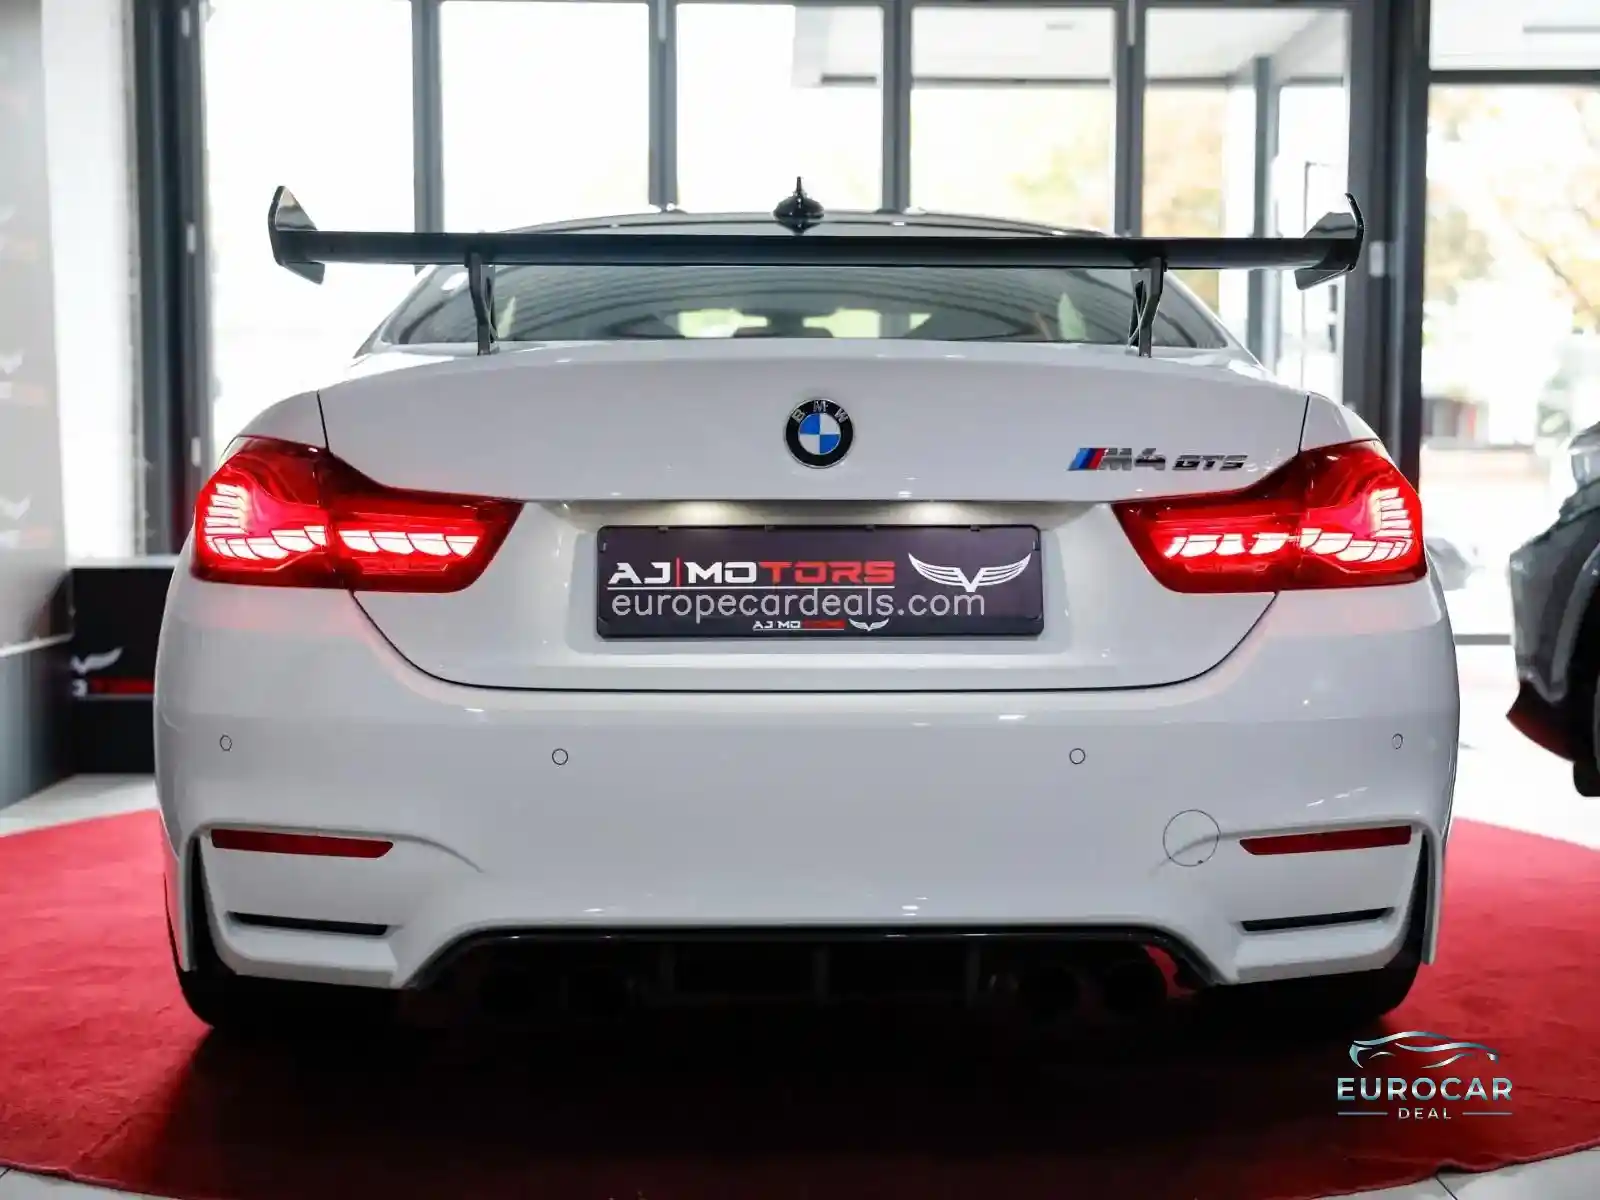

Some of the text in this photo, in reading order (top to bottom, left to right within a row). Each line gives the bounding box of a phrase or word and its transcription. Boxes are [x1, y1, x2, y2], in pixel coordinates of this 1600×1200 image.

[791, 400, 849, 423] BMW
[1095, 447, 1248, 471] M4 GTS
